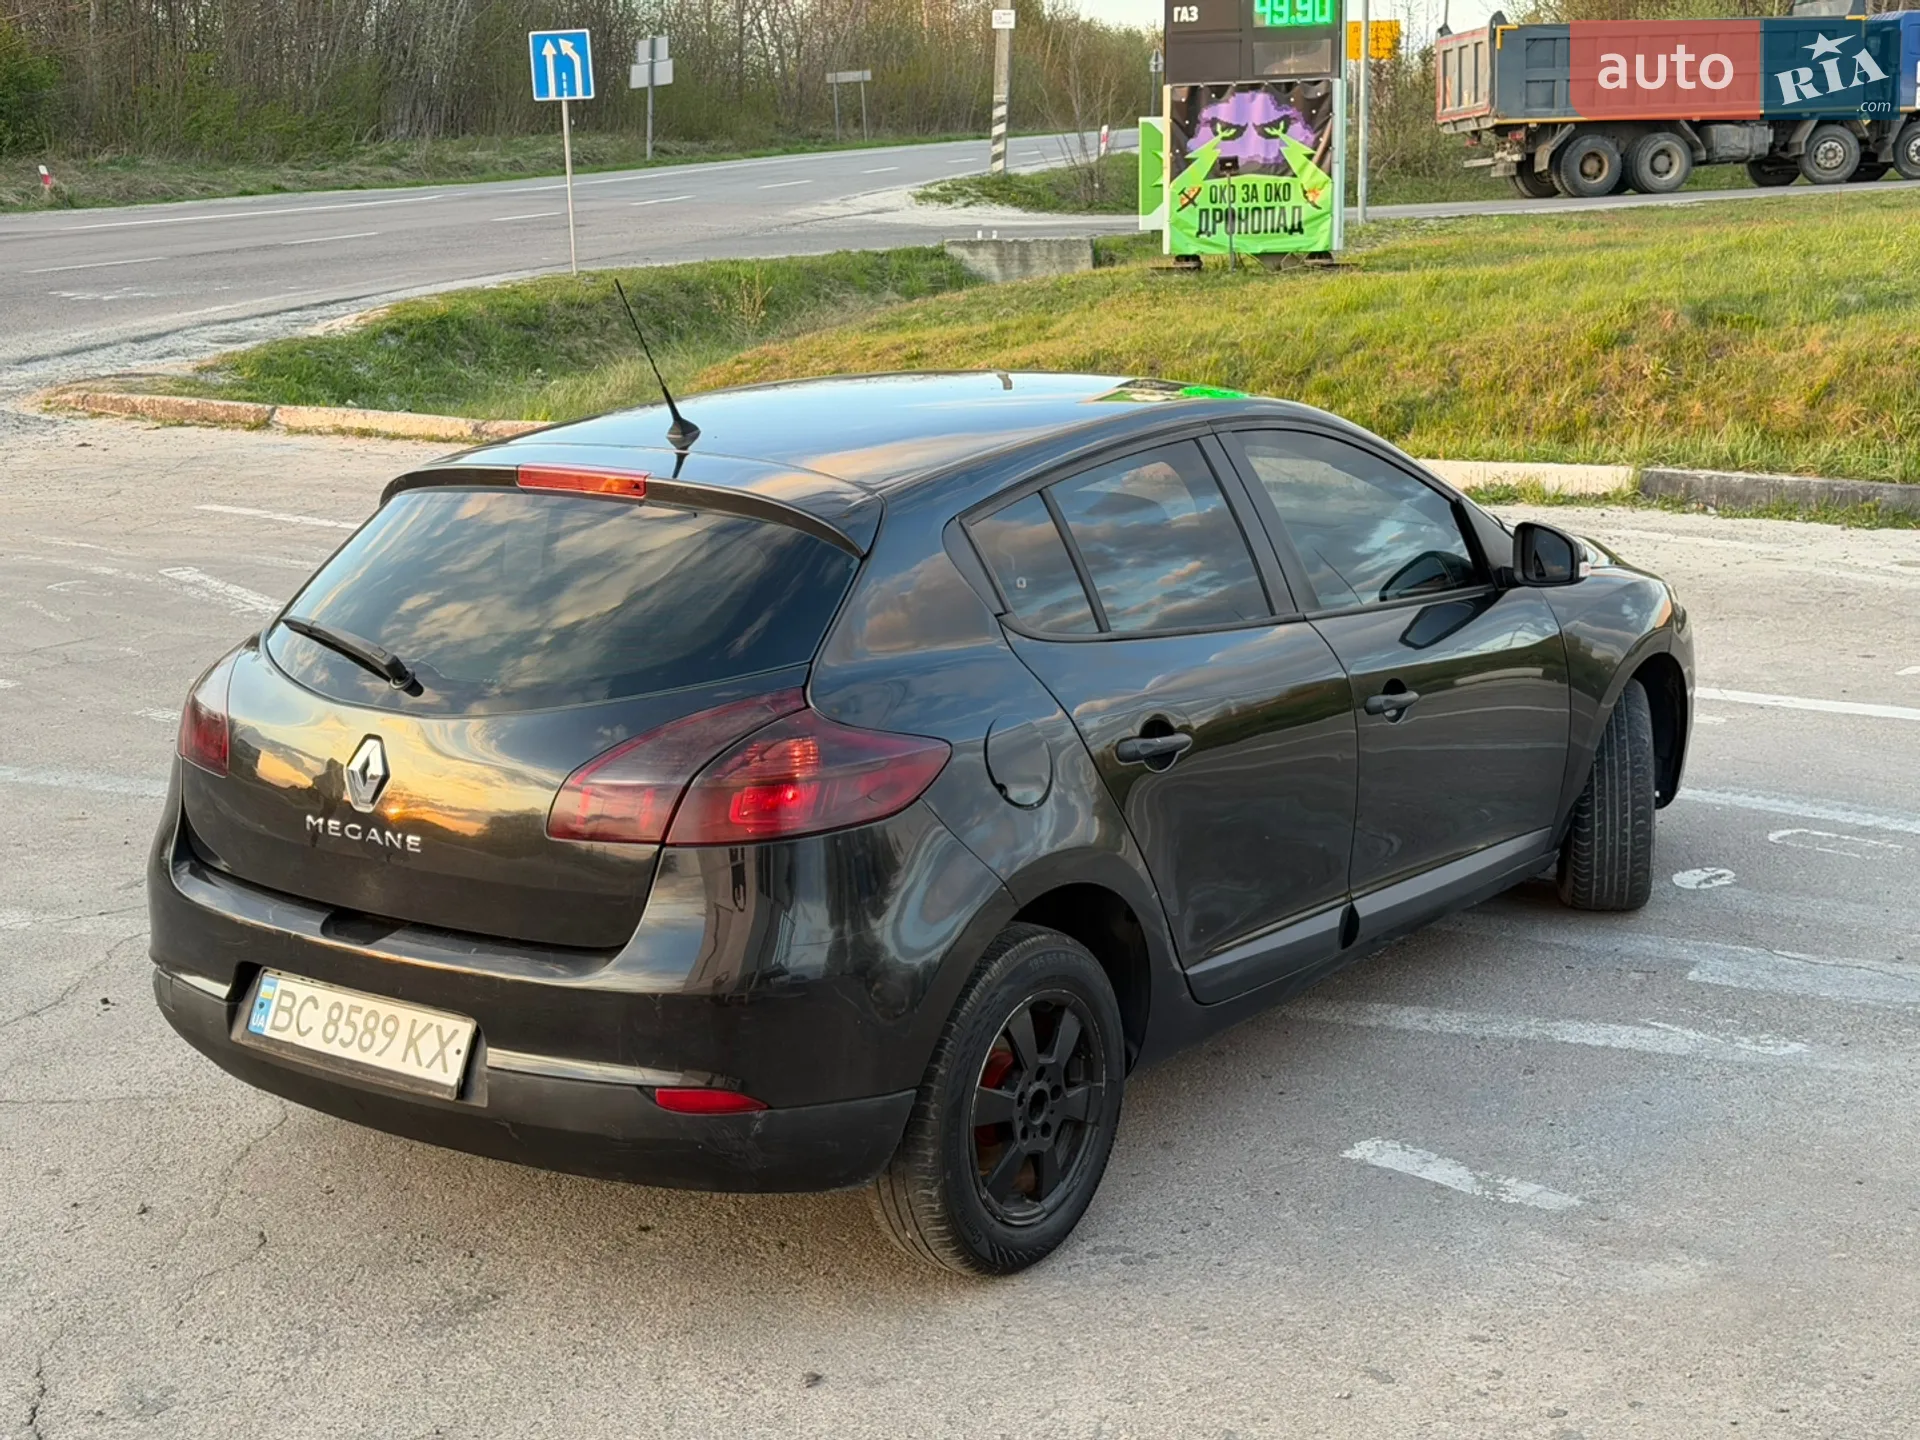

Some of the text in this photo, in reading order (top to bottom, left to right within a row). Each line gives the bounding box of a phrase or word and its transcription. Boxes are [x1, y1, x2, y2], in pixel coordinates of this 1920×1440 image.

[1173, 5, 1199, 23] ГАЗ
[1254, 0, 1333, 26] 49.90
[1209, 182, 1292, 204] ОКО ЗА ОКО
[1195, 205, 1304, 238] ДРОНОПАД
[305, 814, 422, 854] MEGANE
[250, 1013, 266, 1028] UA
[270, 988, 460, 1074] BC 8589 KX
